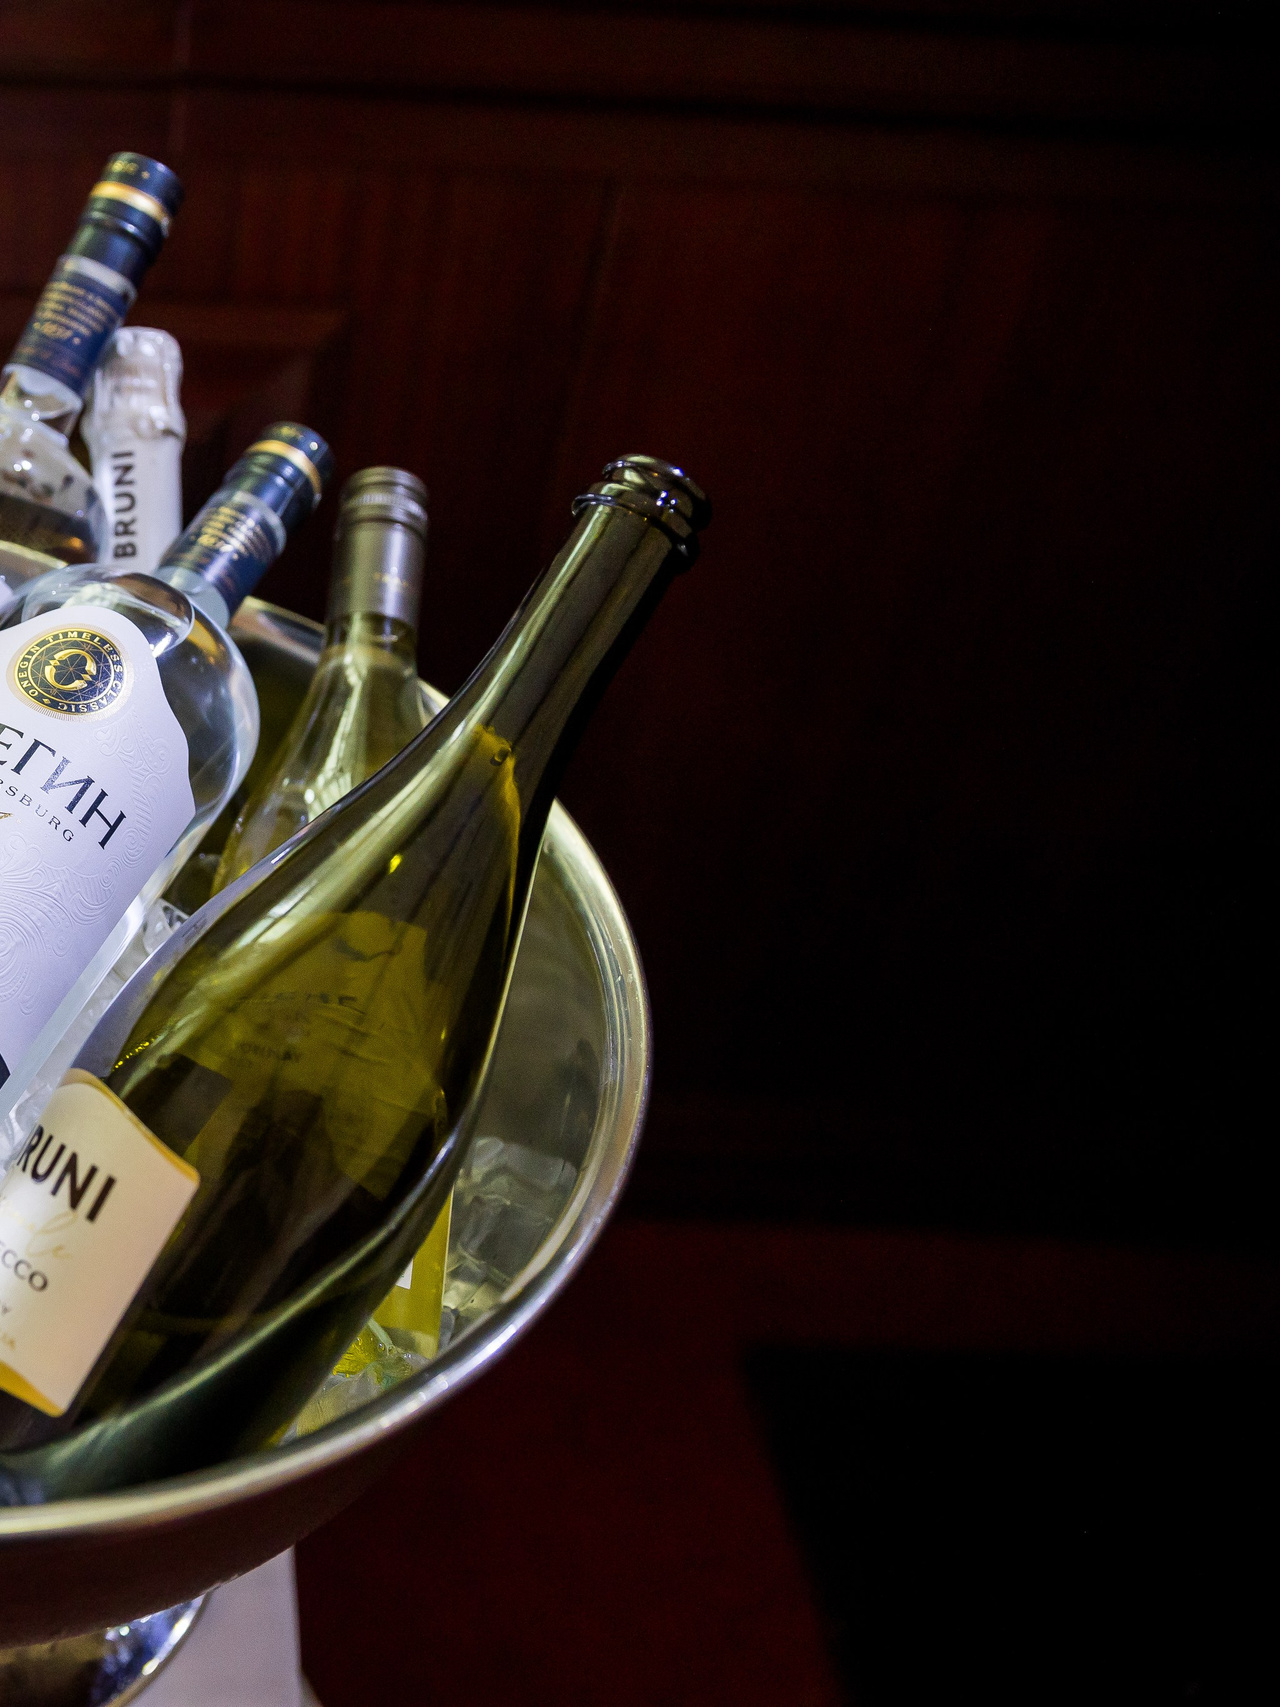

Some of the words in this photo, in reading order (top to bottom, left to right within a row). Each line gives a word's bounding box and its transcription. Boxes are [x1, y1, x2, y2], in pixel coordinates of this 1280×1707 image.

[112, 450, 138, 560] BRUNI
[18, 645, 40, 697] ONEGIN
[45, 631, 123, 673] TIMELESS
[58, 681, 122, 712] CLASSIC
[16, 1124, 117, 1224] RUNI
